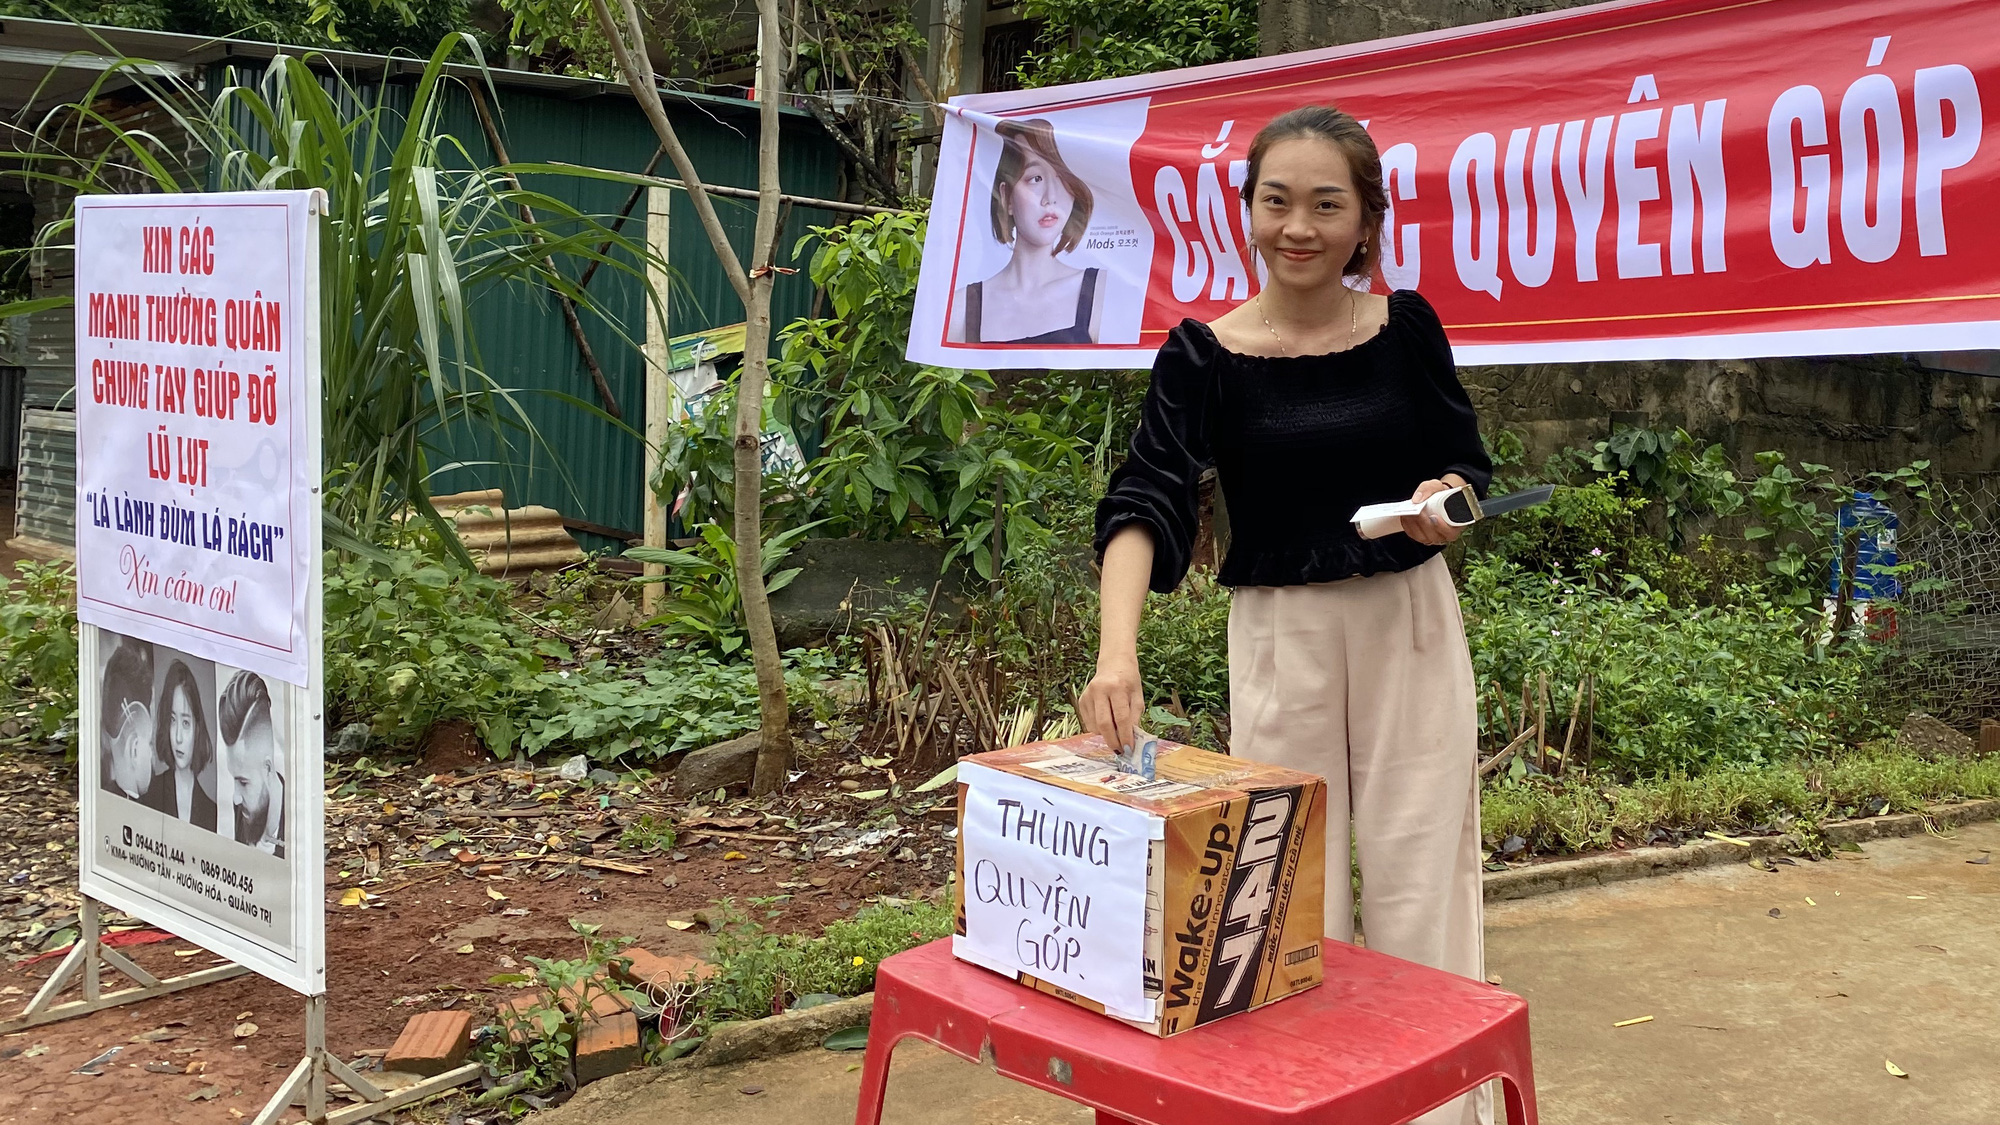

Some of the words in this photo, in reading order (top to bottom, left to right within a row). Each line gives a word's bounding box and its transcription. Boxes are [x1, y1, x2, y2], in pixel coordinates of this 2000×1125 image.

[1448, 74, 1727, 301] QUYÊN
[1767, 35, 1983, 270] GÓP
[142, 226, 172, 274] XIN
[179, 216, 214, 276] CÁC
[1086, 238, 1115, 250] Mods
[88, 293, 140, 349] MẠNH
[146, 287, 217, 347] THƯỜNG
[225, 290, 281, 352] QUÂN
[92, 358, 149, 410] CHUNG
[155, 365, 186, 414] TAY
[193, 361, 240, 421] GIÚP
[247, 364, 277, 426] ĐỠ
[147, 424, 170, 480] LŨ
[176, 436, 209, 496] LỤT
[114, 491, 154, 538] LÀNH
[160, 499, 196, 547] ĐÙM
[202, 507, 222, 552] LÁ
[119, 544, 159, 599] Xin
[164, 570, 204, 607] cảm
[134, 833, 185, 866] 0944.821.444
[200, 859, 254, 895] 0869.060.456
[998, 797, 1109, 867] THÙNG
[129, 851, 156, 873] HƯỚNG
[176, 872, 203, 894] HƯỚNG
[205, 884, 222, 903] HÓA
[228, 894, 258, 918] QUẢNG
[260, 907, 272, 927] TRỊ
[974, 859, 1091, 930] QUYÊN
[1214, 793, 1293, 1009] 247
[1192, 981, 1204, 1006] the
[1200, 929, 1216, 976] coffee
[1212, 854, 1232, 924] innovator
